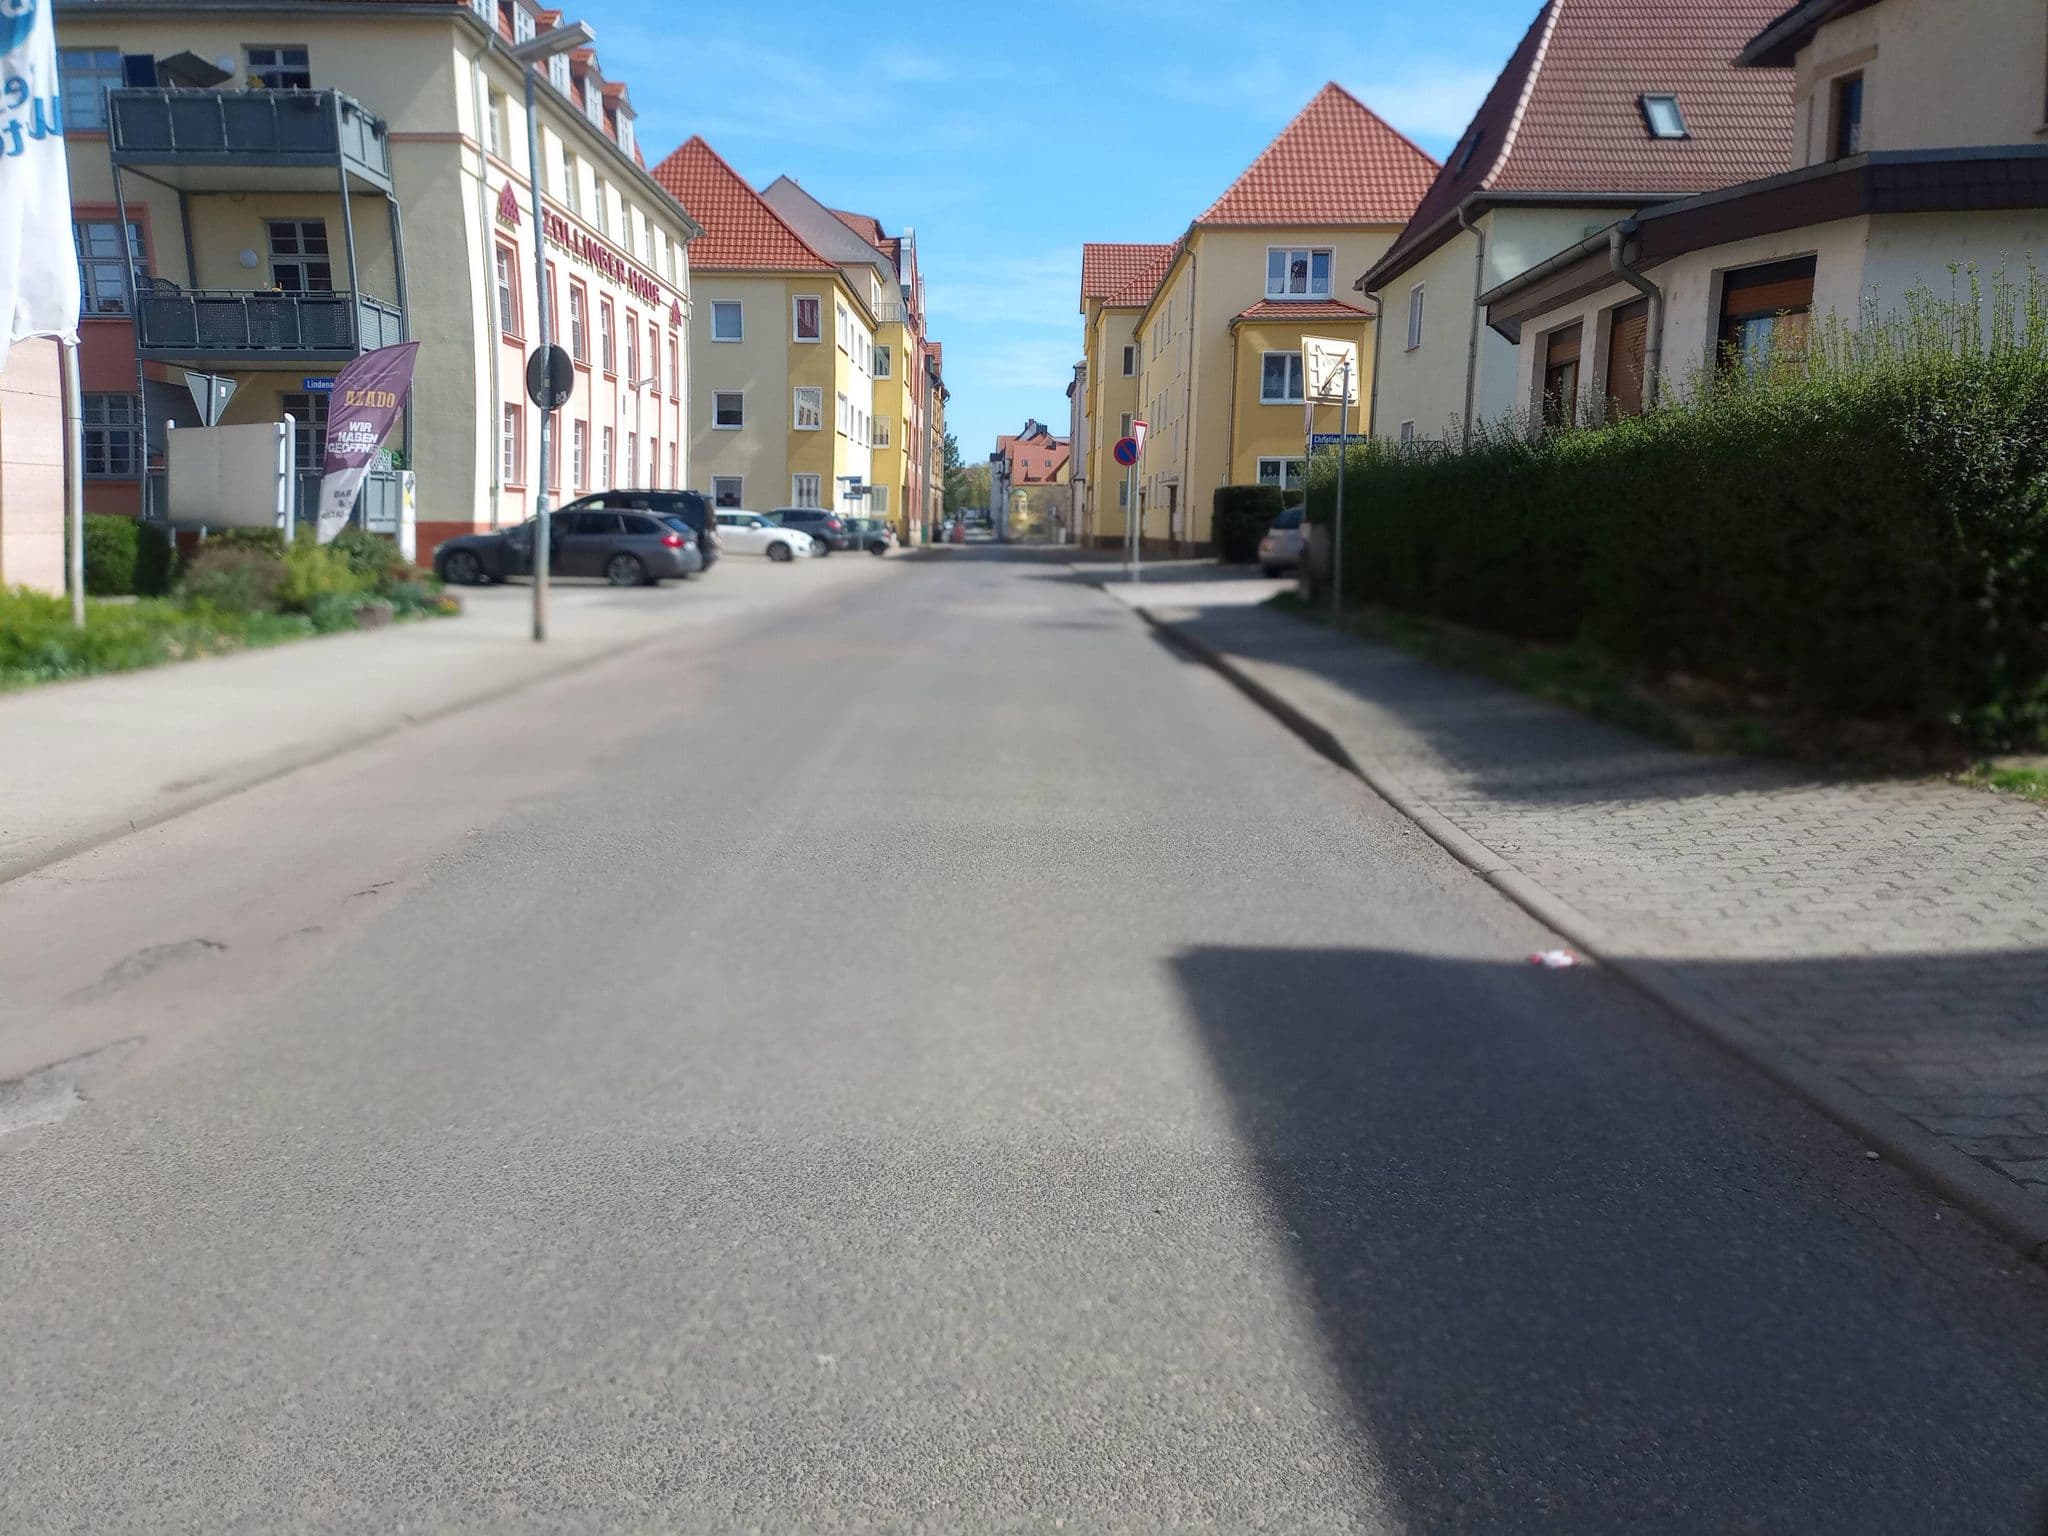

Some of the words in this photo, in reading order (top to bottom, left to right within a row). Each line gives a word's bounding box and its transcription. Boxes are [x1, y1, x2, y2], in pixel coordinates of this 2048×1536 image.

[541, 206, 625, 284] ZOLLINGER
[628, 266, 661, 306] HAUS
[306, 380, 334, 389] Lindena
[344, 390, 396, 409] AZADO
[349, 421, 373, 433] WIR
[337, 431, 379, 444] HABEN
